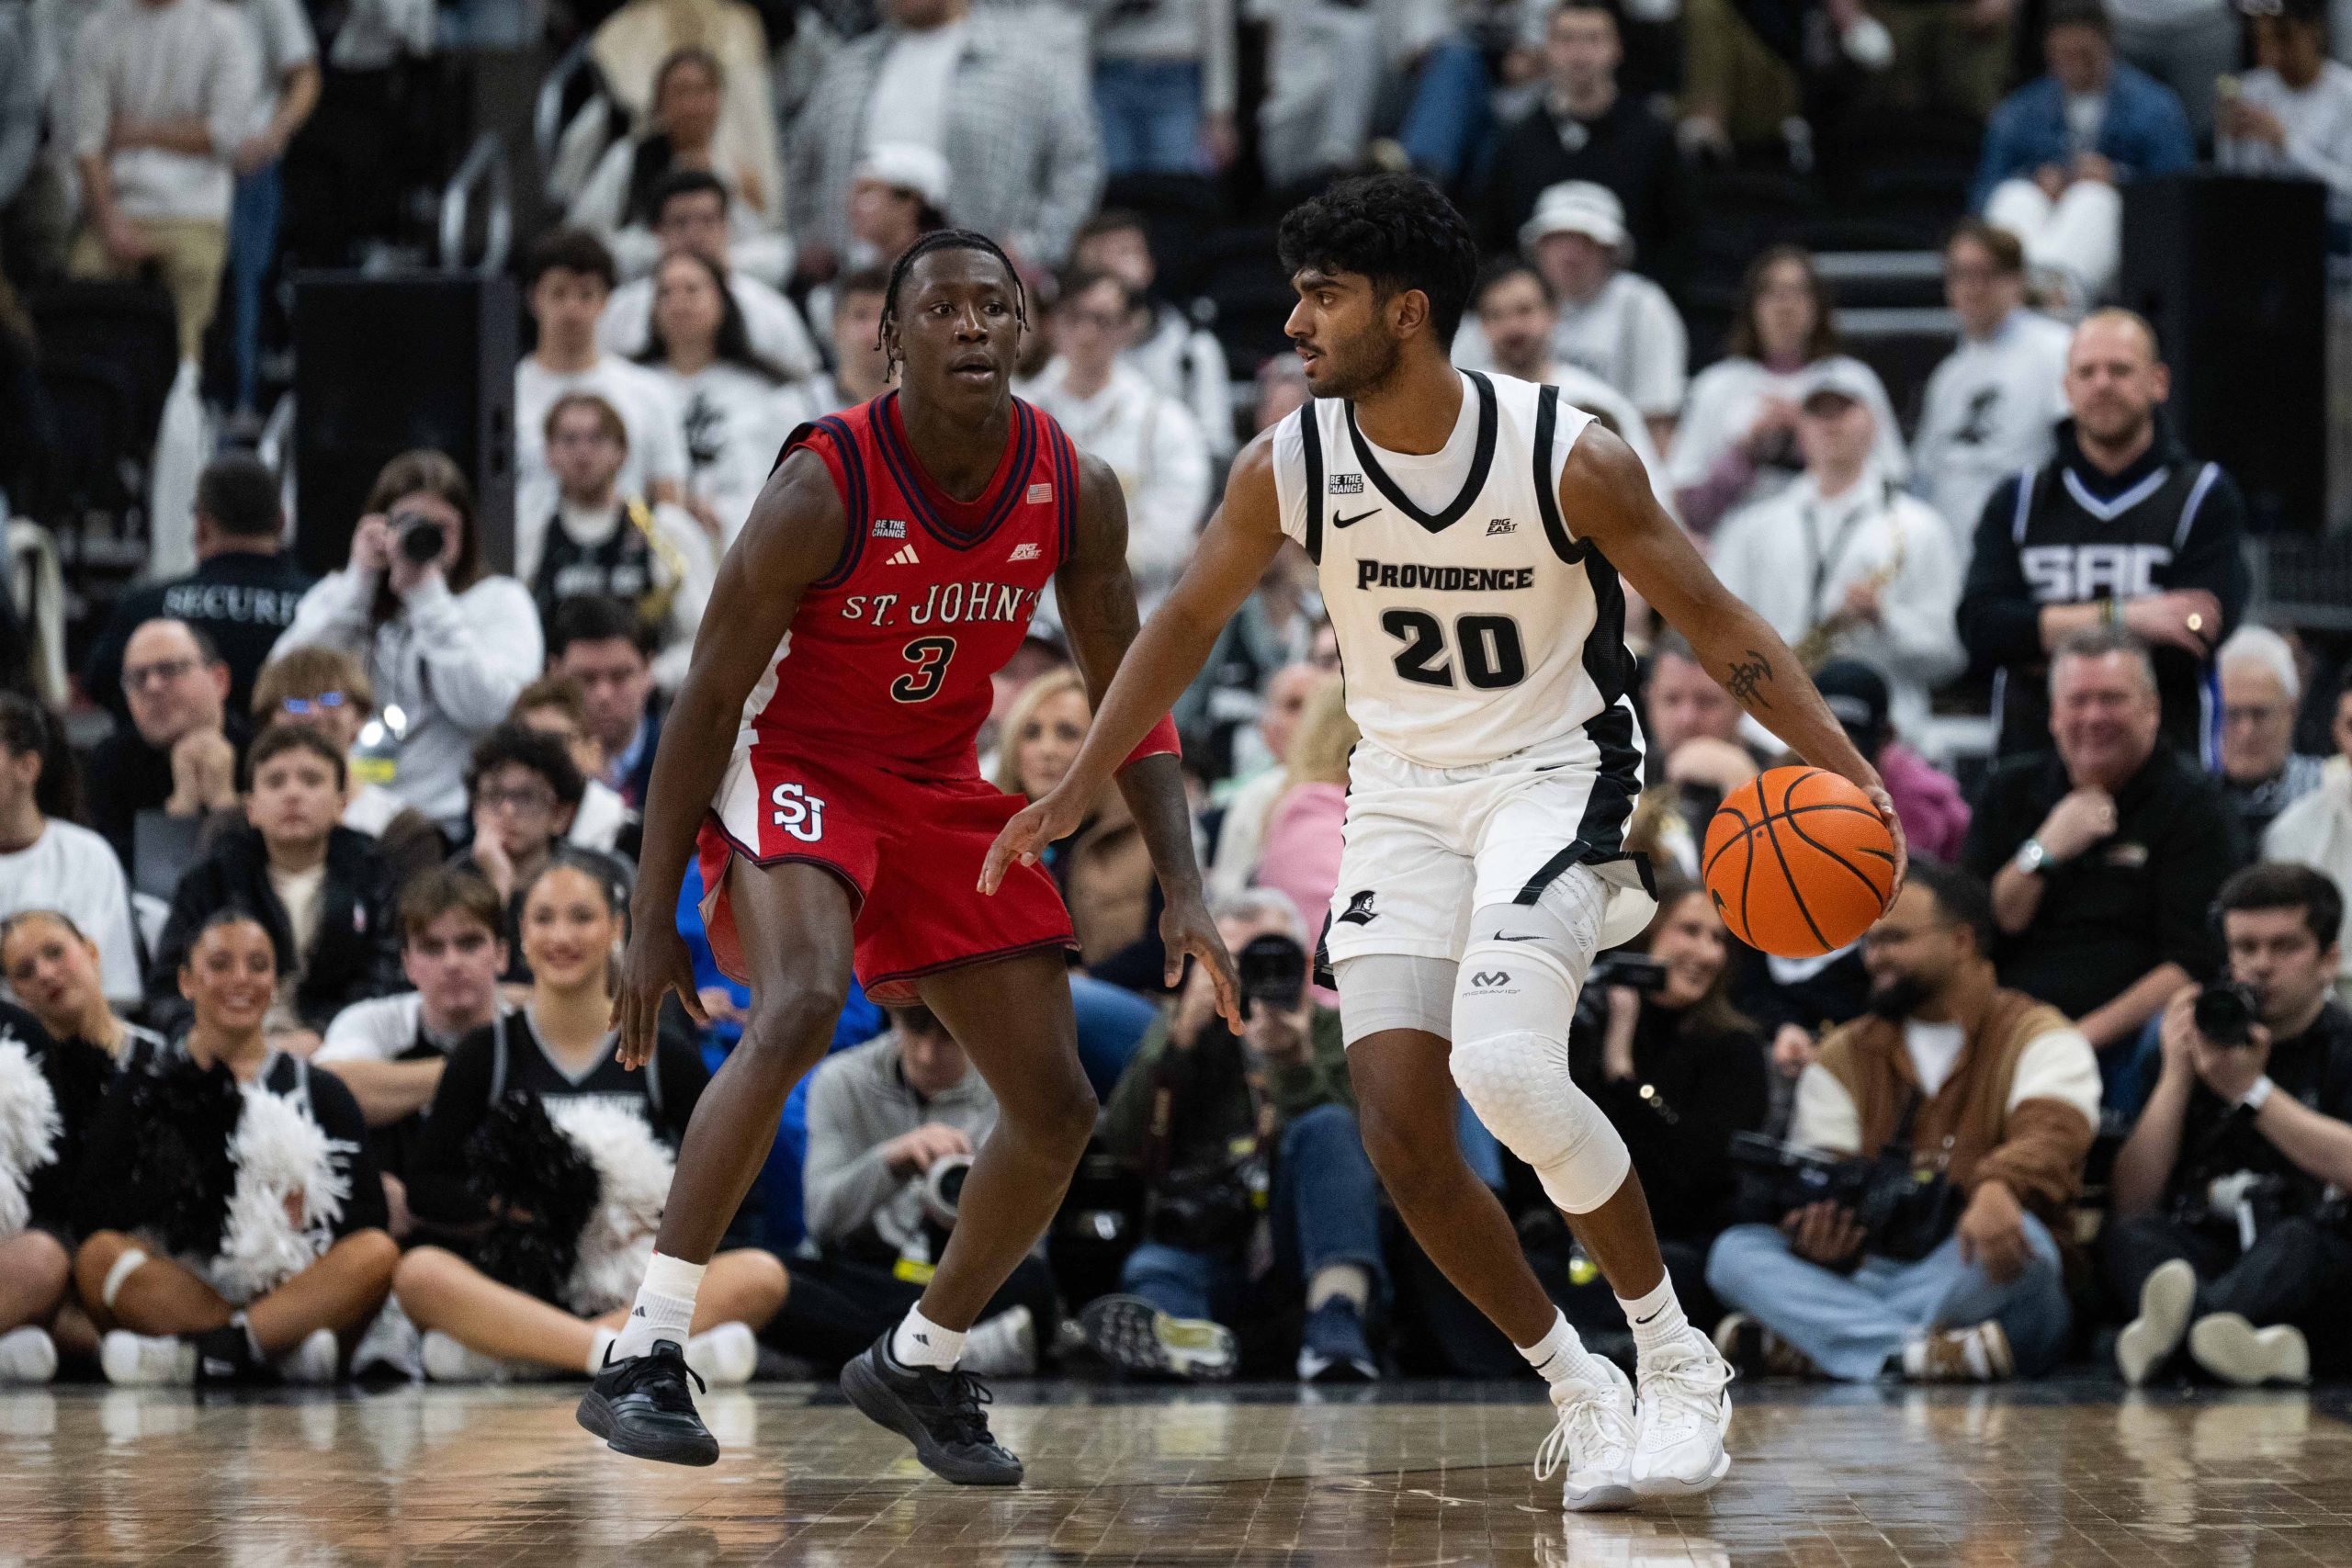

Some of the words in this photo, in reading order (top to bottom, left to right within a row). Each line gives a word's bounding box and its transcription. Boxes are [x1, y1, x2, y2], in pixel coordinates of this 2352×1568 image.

[1329, 483, 1363, 494] CHANGE
[1330, 475, 1341, 484] BE
[1343, 474, 1361, 484] THE
[872, 528, 906, 539] CHANGE
[875, 519, 887, 528] BE
[889, 520, 906, 530] THE
[1487, 524, 1518, 533] EAST
[1355, 558, 1536, 592] PROVIDENCE
[2021, 544, 2174, 603] SAC
[163, 583, 298, 626] SECURI
[841, 592, 899, 626] ST.
[1379, 606, 1529, 692] 20
[889, 635, 957, 704] 3
